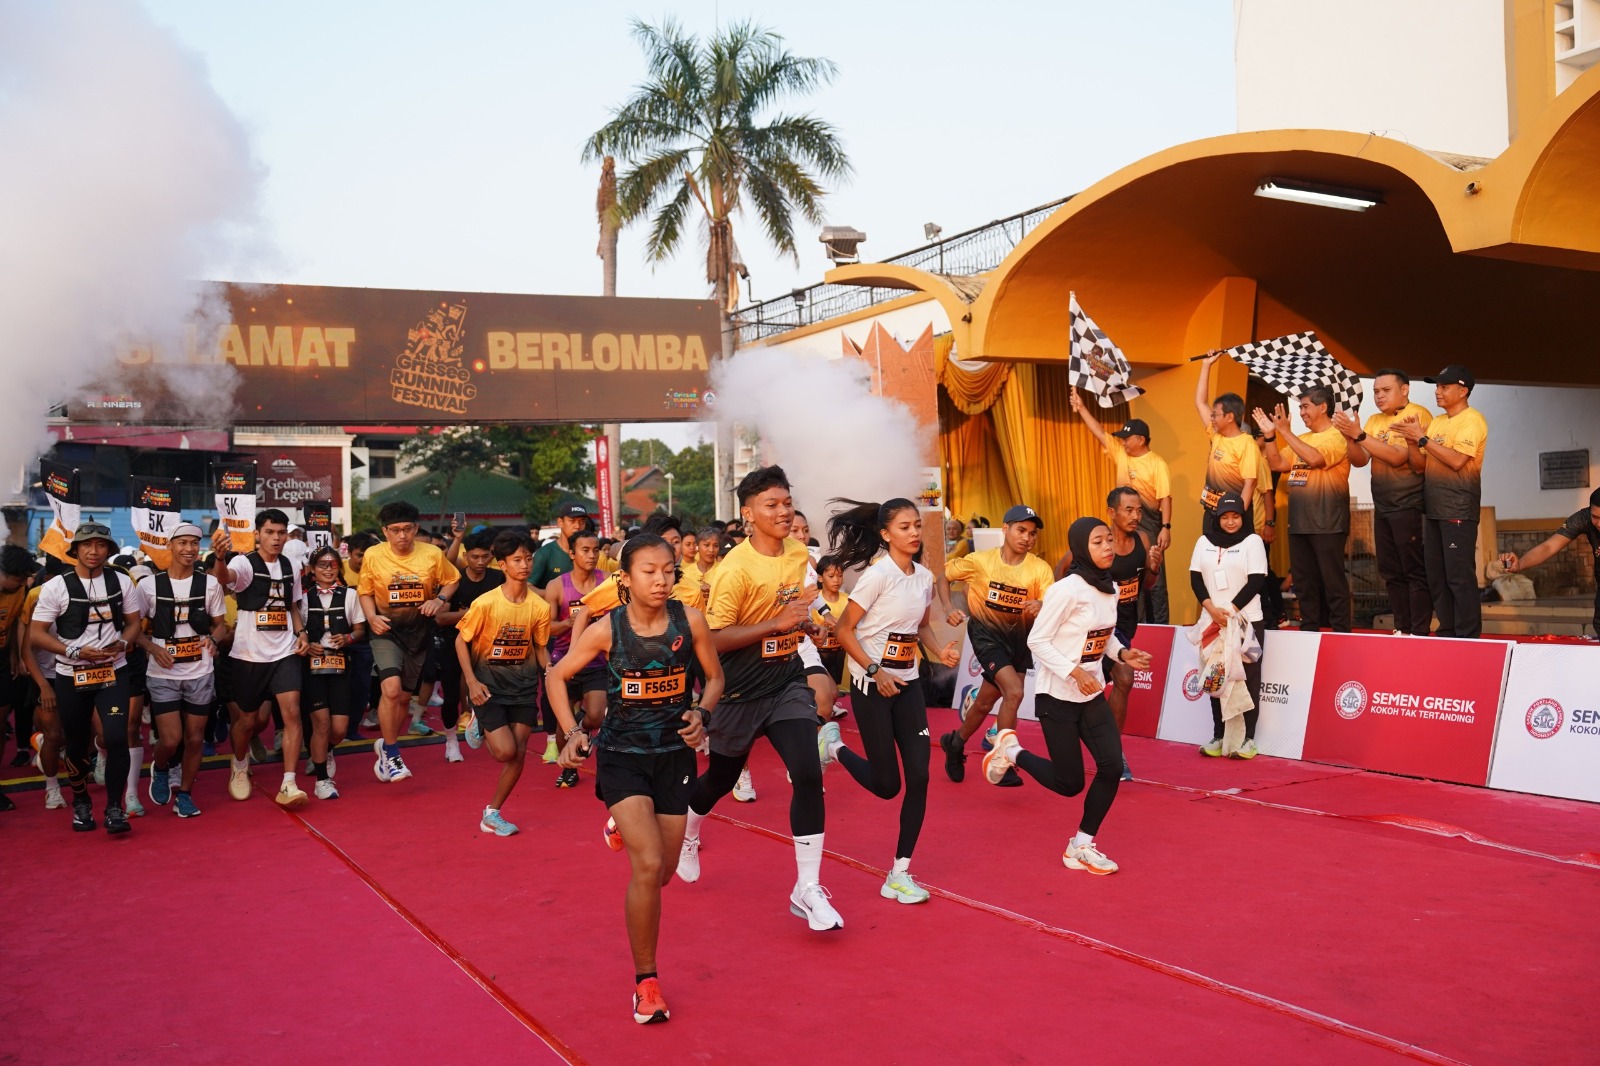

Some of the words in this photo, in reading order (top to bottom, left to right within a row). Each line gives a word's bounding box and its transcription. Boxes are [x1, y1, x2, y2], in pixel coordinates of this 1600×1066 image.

[117, 324, 356, 368] SLAMAT
[487, 331, 709, 371] BERLOMBA
[390, 368, 477, 401] RUNNING
[391, 386, 467, 414] FESTIVAL
[266, 478, 321, 493] Gedhong
[224, 497, 238, 516] 5K
[148, 511, 165, 533] 5K
[151, 535, 168, 546] 00.3
[267, 613, 287, 621] PACER
[176, 643, 200, 654] PACER
[321, 658, 343, 666] PACER
[86, 669, 113, 681] PACER
[1133, 670, 1153, 682] ESIK
[645, 678, 679, 694] F5653
[1259, 681, 1290, 696] RESIK
[1372, 691, 1420, 708] SEMEN
[1423, 696, 1476, 714] GRESIK
[1370, 705, 1399, 716] KOKOH
[1400, 708, 1417, 718] TAK
[1418, 710, 1475, 724] TERTANDINGI
[1569, 725, 1600, 736] KOKO
